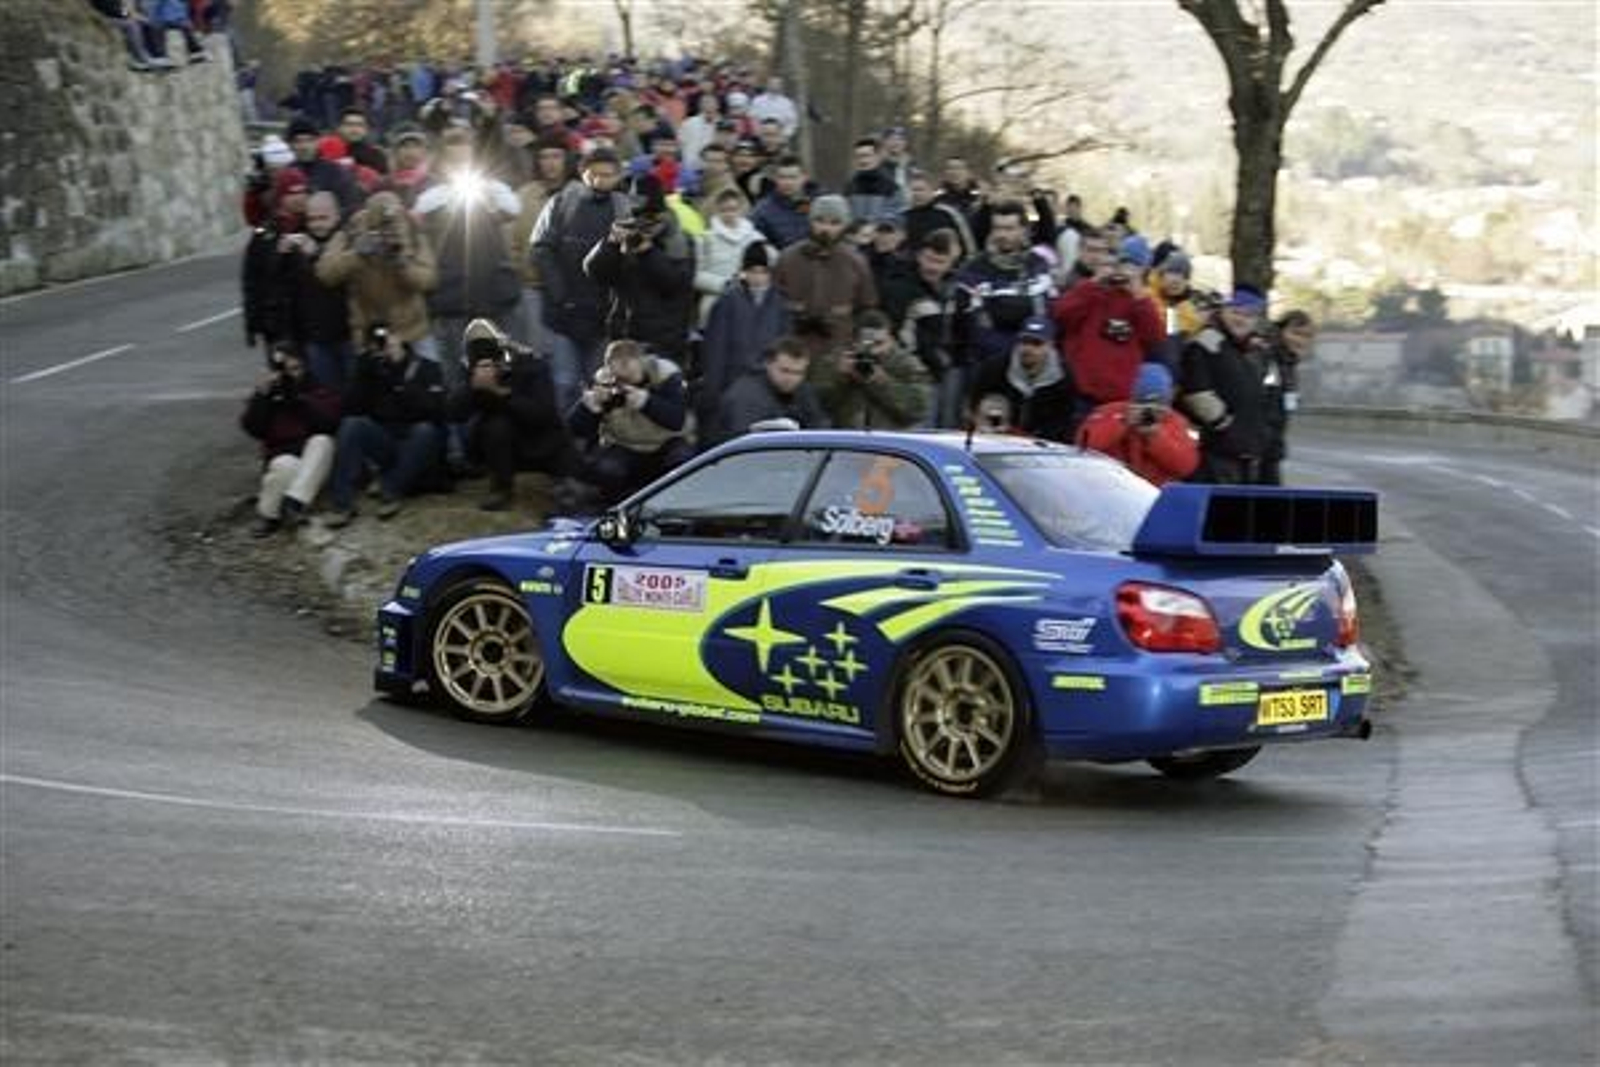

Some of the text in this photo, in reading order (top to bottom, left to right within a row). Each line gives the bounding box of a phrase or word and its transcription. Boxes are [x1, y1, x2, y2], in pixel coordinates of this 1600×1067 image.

[591, 568, 607, 602] 5
[635, 573, 686, 590] 2005
[762, 696, 859, 723] SUBARU
[1300, 695, 1323, 716] SRT
